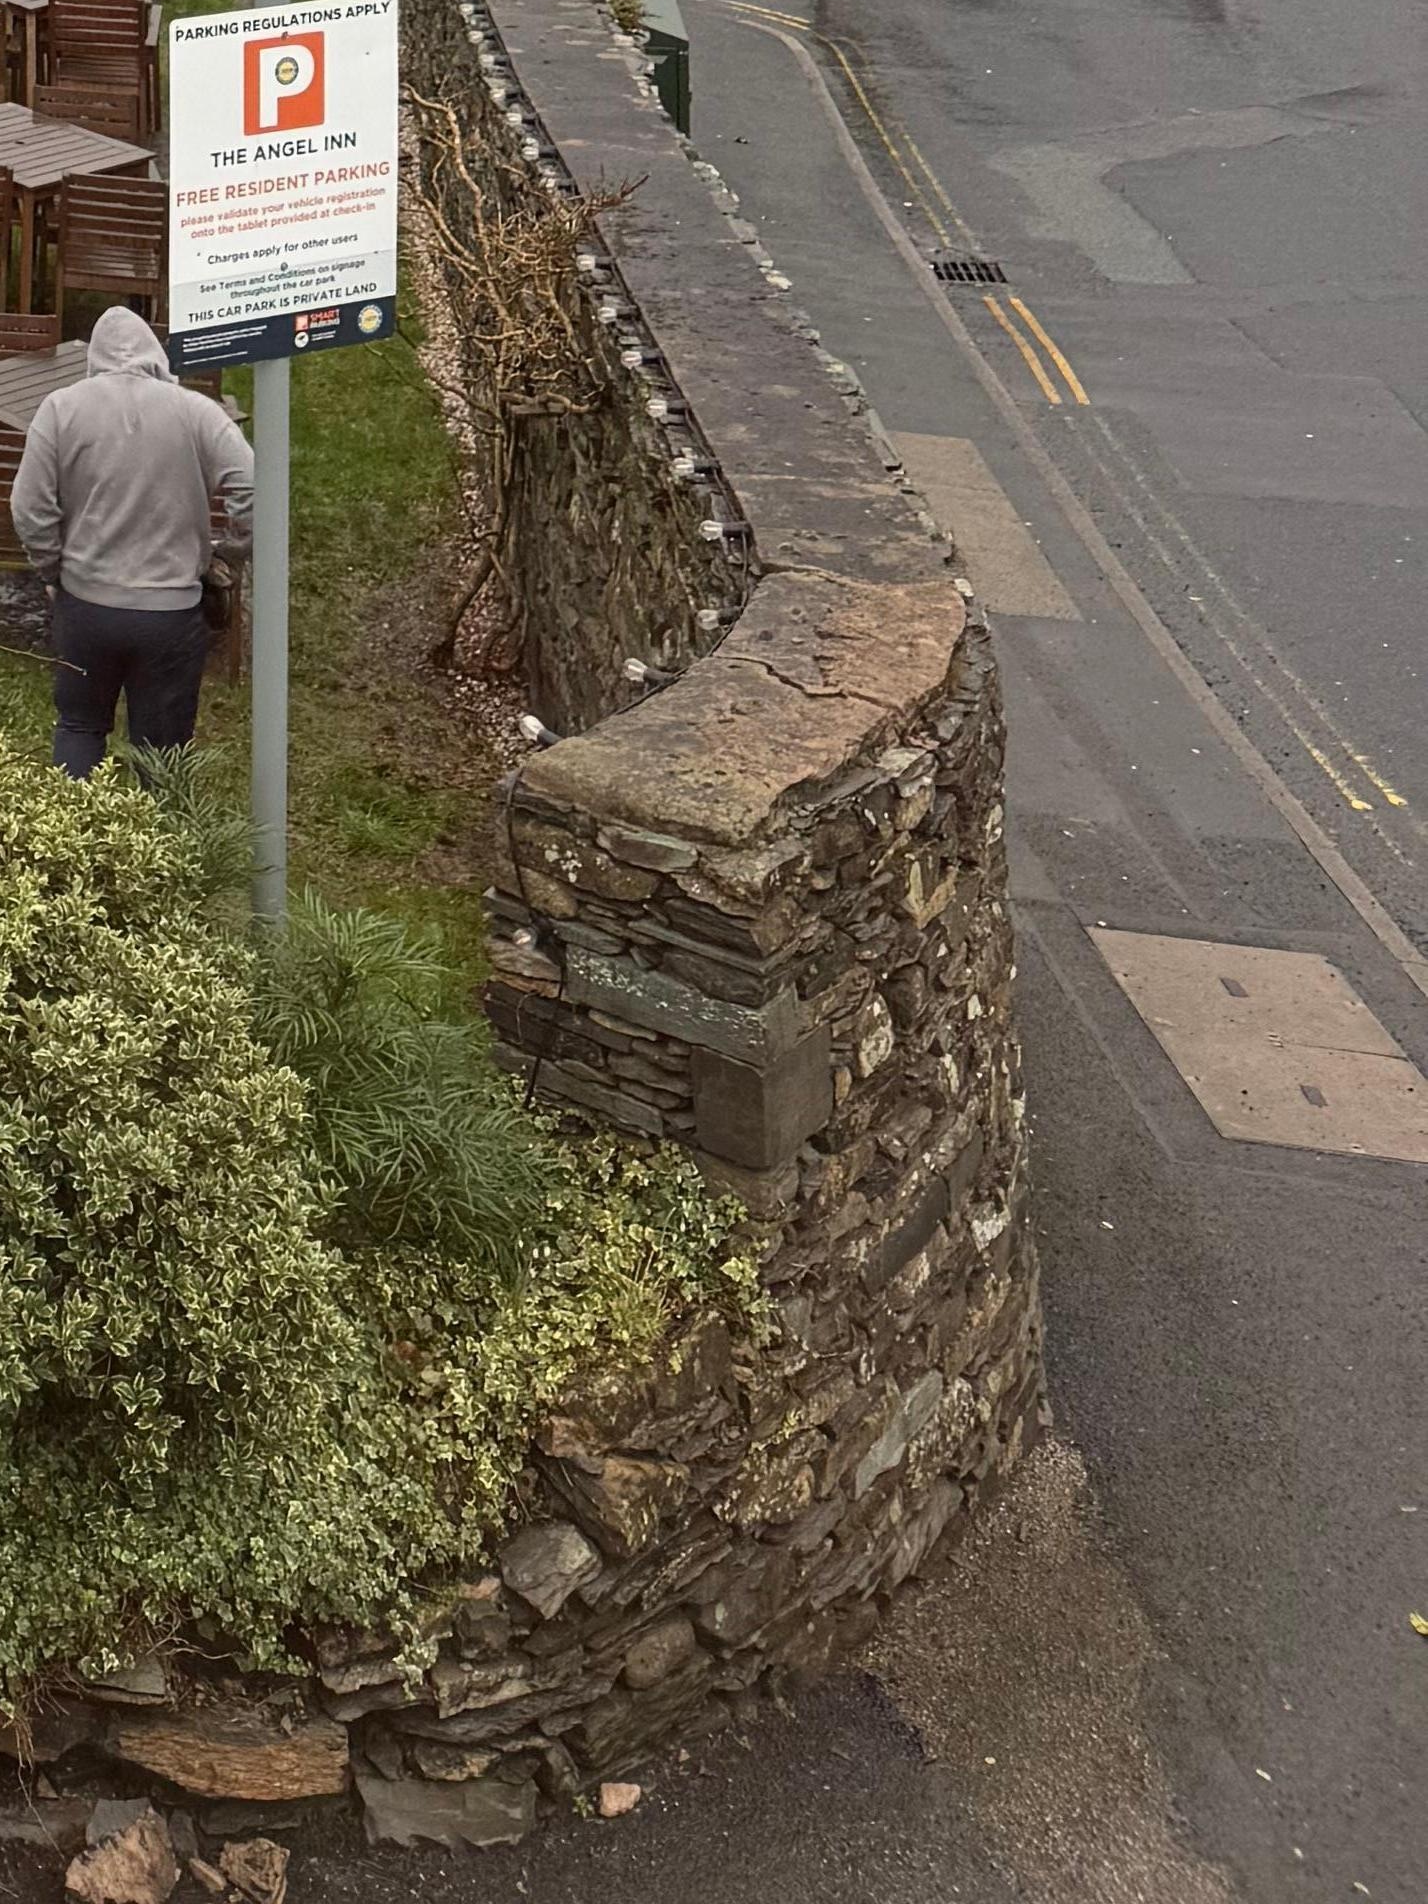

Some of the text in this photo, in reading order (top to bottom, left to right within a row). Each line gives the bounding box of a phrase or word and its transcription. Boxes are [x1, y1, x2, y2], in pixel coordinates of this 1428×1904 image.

[176, 0, 391, 42] PARKING REGULATIONS APPLY
[211, 131, 357, 168] THE ANGEL INN
[176, 161, 391, 207] FREE RESIDENT PARKING
[180, 186, 386, 229] please validate your vehicle registration
[190, 201, 376, 240] onto the tablet provided at check-in
[207, 233, 358, 266] Charges apply for other users
[199, 259, 365, 294] See Terms and Conditions on signage
[230, 273, 336, 300] throughout the car park
[188, 282, 377, 323] THIS CAR PARK IS PRIVATE LAND
